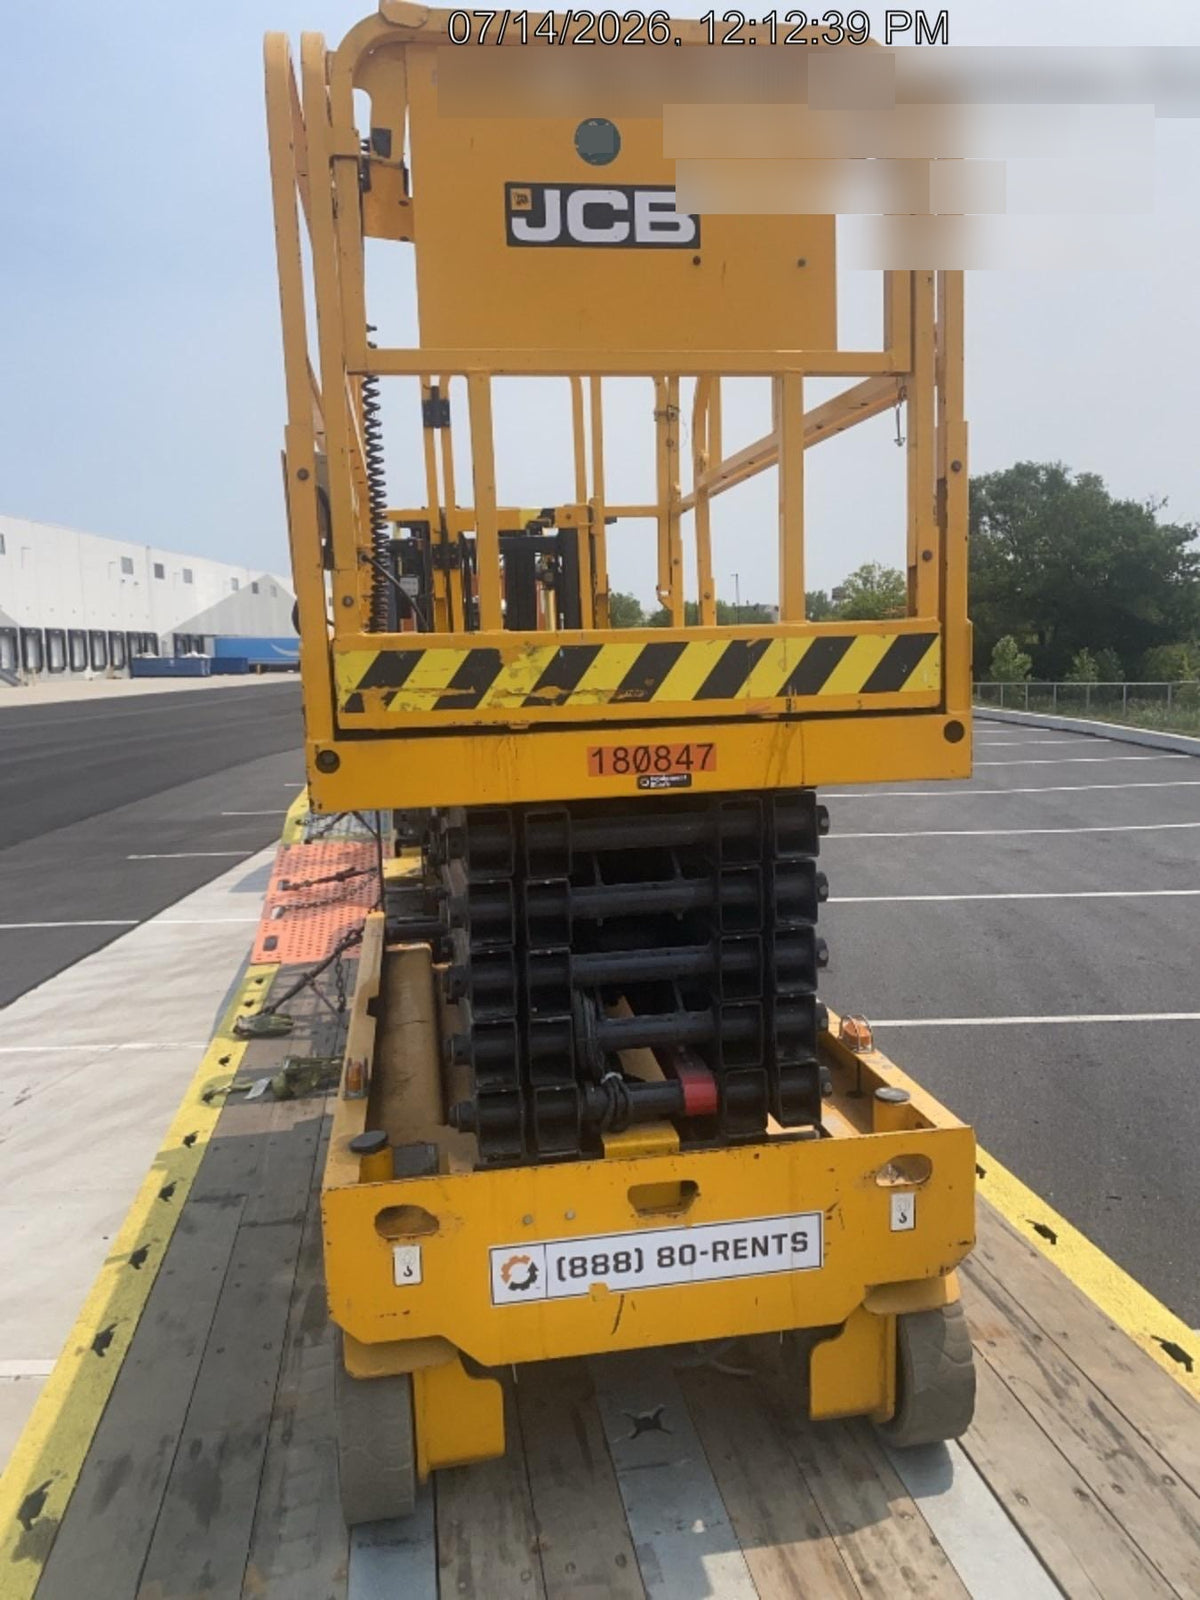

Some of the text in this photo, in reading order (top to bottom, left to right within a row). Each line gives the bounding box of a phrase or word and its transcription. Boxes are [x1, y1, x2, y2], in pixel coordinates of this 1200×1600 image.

[511, 189, 696, 243] JCB
[591, 742, 714, 775] 180847
[556, 1231, 809, 1282] (888) 80-RENTS
